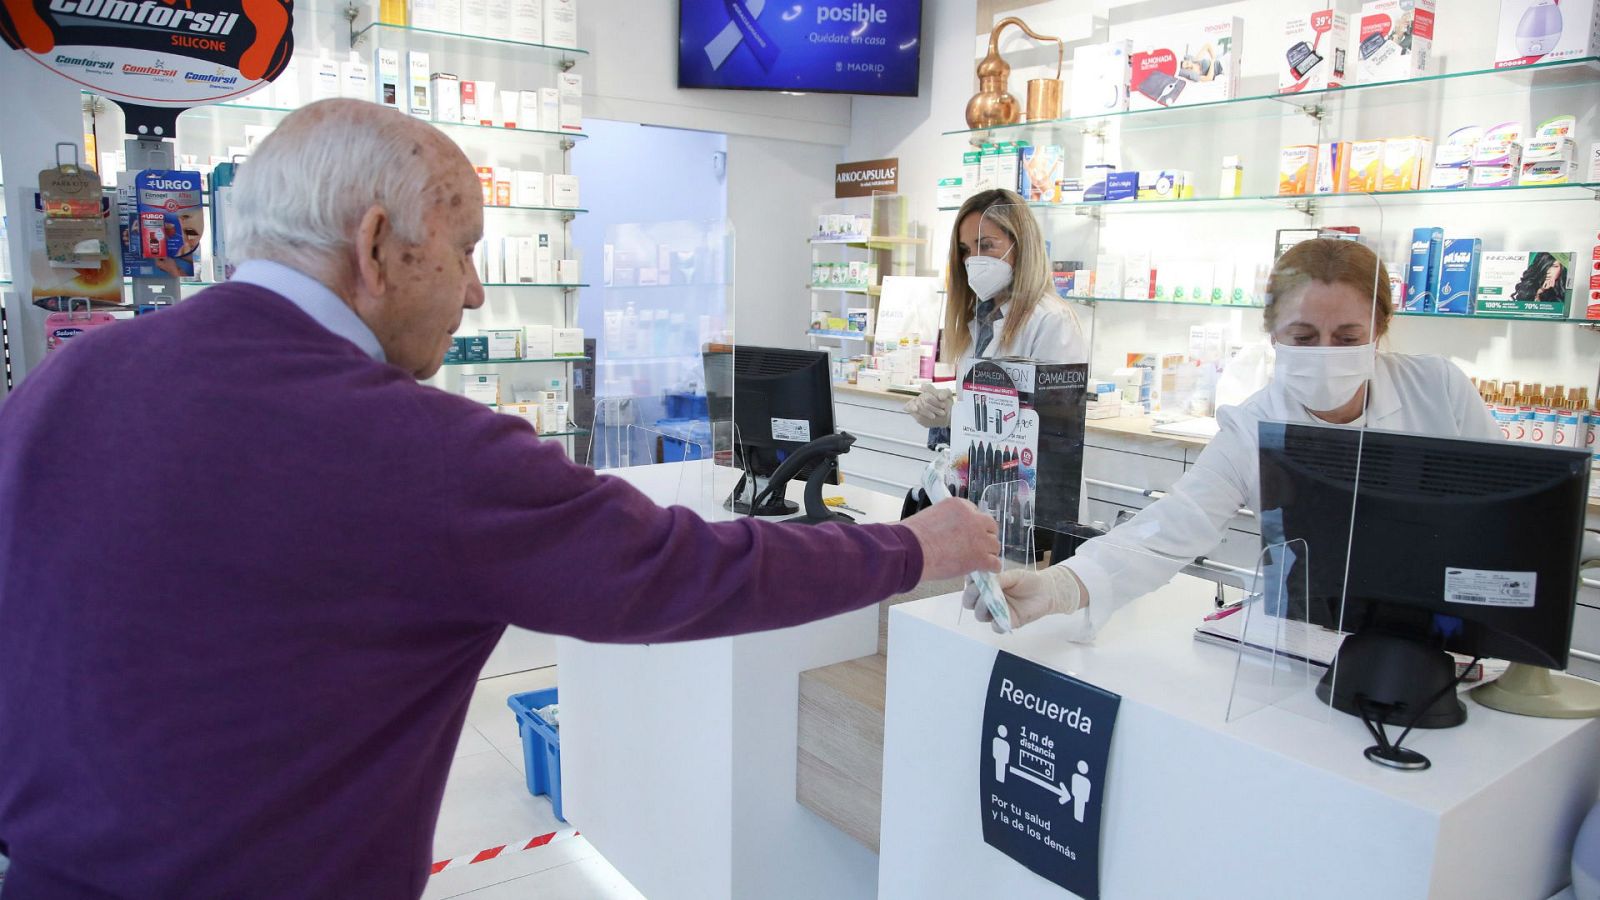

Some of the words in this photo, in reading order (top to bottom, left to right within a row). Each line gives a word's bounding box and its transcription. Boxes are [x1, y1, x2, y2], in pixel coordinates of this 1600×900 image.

[816, 3, 888, 24] posible
[171, 35, 227, 52] SILICONE
[809, 32, 849, 45] Quédate
[851, 36, 863, 44] en
[864, 36, 886, 45] casa
[55, 54, 115, 70] Comforsil
[122, 63, 178, 77] Comforsil
[847, 63, 885, 73] MADRID
[184, 71, 237, 84] Comforsil
[156, 180, 192, 190] URGO
[974, 370, 1005, 381] CAMALEON
[1038, 371, 1086, 384] CAMALEON
[999, 678, 1092, 734] Recuerda
[1020, 726, 1027, 737] 1
[1029, 733, 1039, 743] m
[1041, 736, 1054, 749] de
[1019, 738, 1056, 760] distancia
[991, 793, 1008, 809] Por
[1010, 801, 1022, 816] tu
[1024, 807, 1051, 831] salud
[991, 809, 998, 820] y
[1000, 811, 1009, 825] la
[1011, 816, 1024, 832] de
[1026, 823, 1041, 841] los
[1044, 832, 1077, 861] demás
